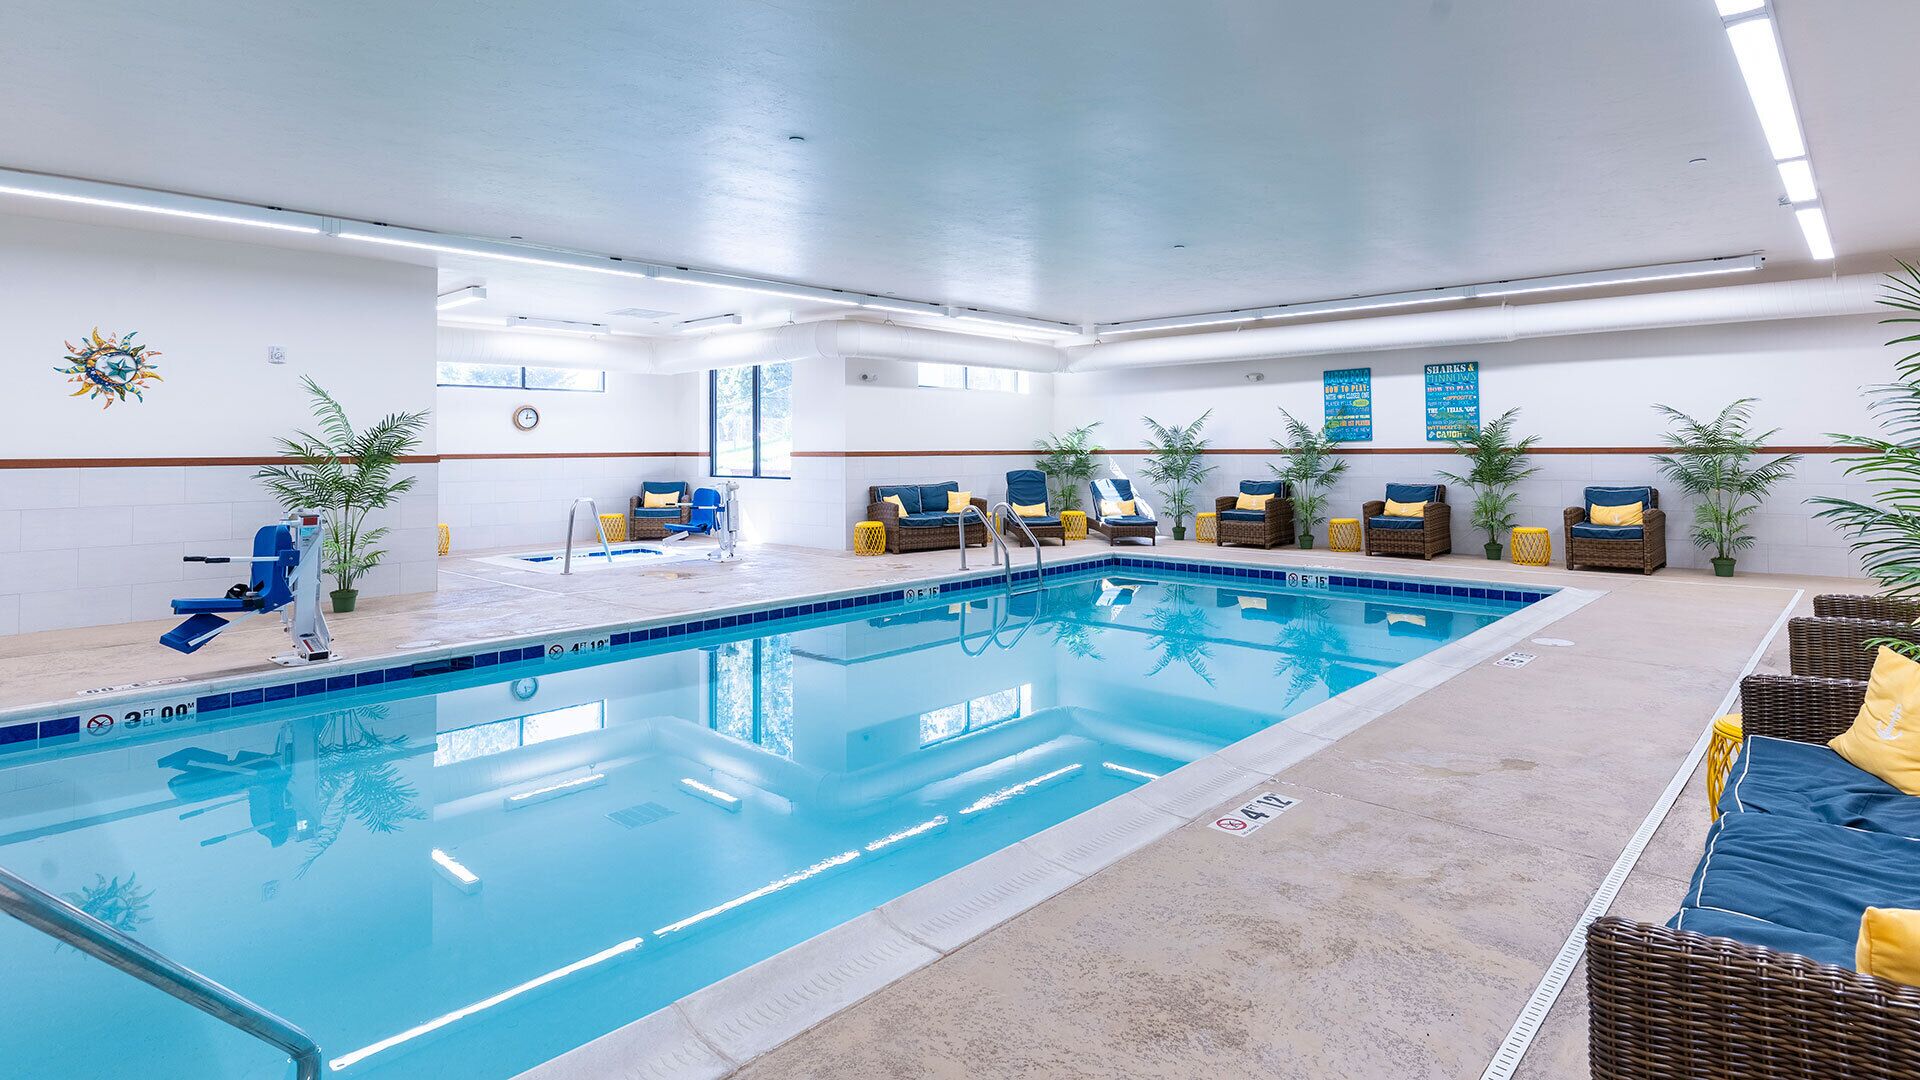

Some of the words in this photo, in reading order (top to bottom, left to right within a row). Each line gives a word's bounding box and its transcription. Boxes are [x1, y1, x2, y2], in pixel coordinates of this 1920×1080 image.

[1426, 364, 1466, 374] SHARKS
[1467, 363, 1475, 372] &
[1325, 371, 1349, 383] MARCO
[1350, 369, 1369, 382] POLO
[1426, 372, 1477, 383] MINNOWS
[1325, 385, 1339, 394] HOW
[1341, 385, 1349, 393] TO
[1351, 383, 1370, 393] PLAY:
[143, 708, 156, 718] FT
[1240, 808, 1270, 820] 4
[1256, 796, 1293, 809] 12
